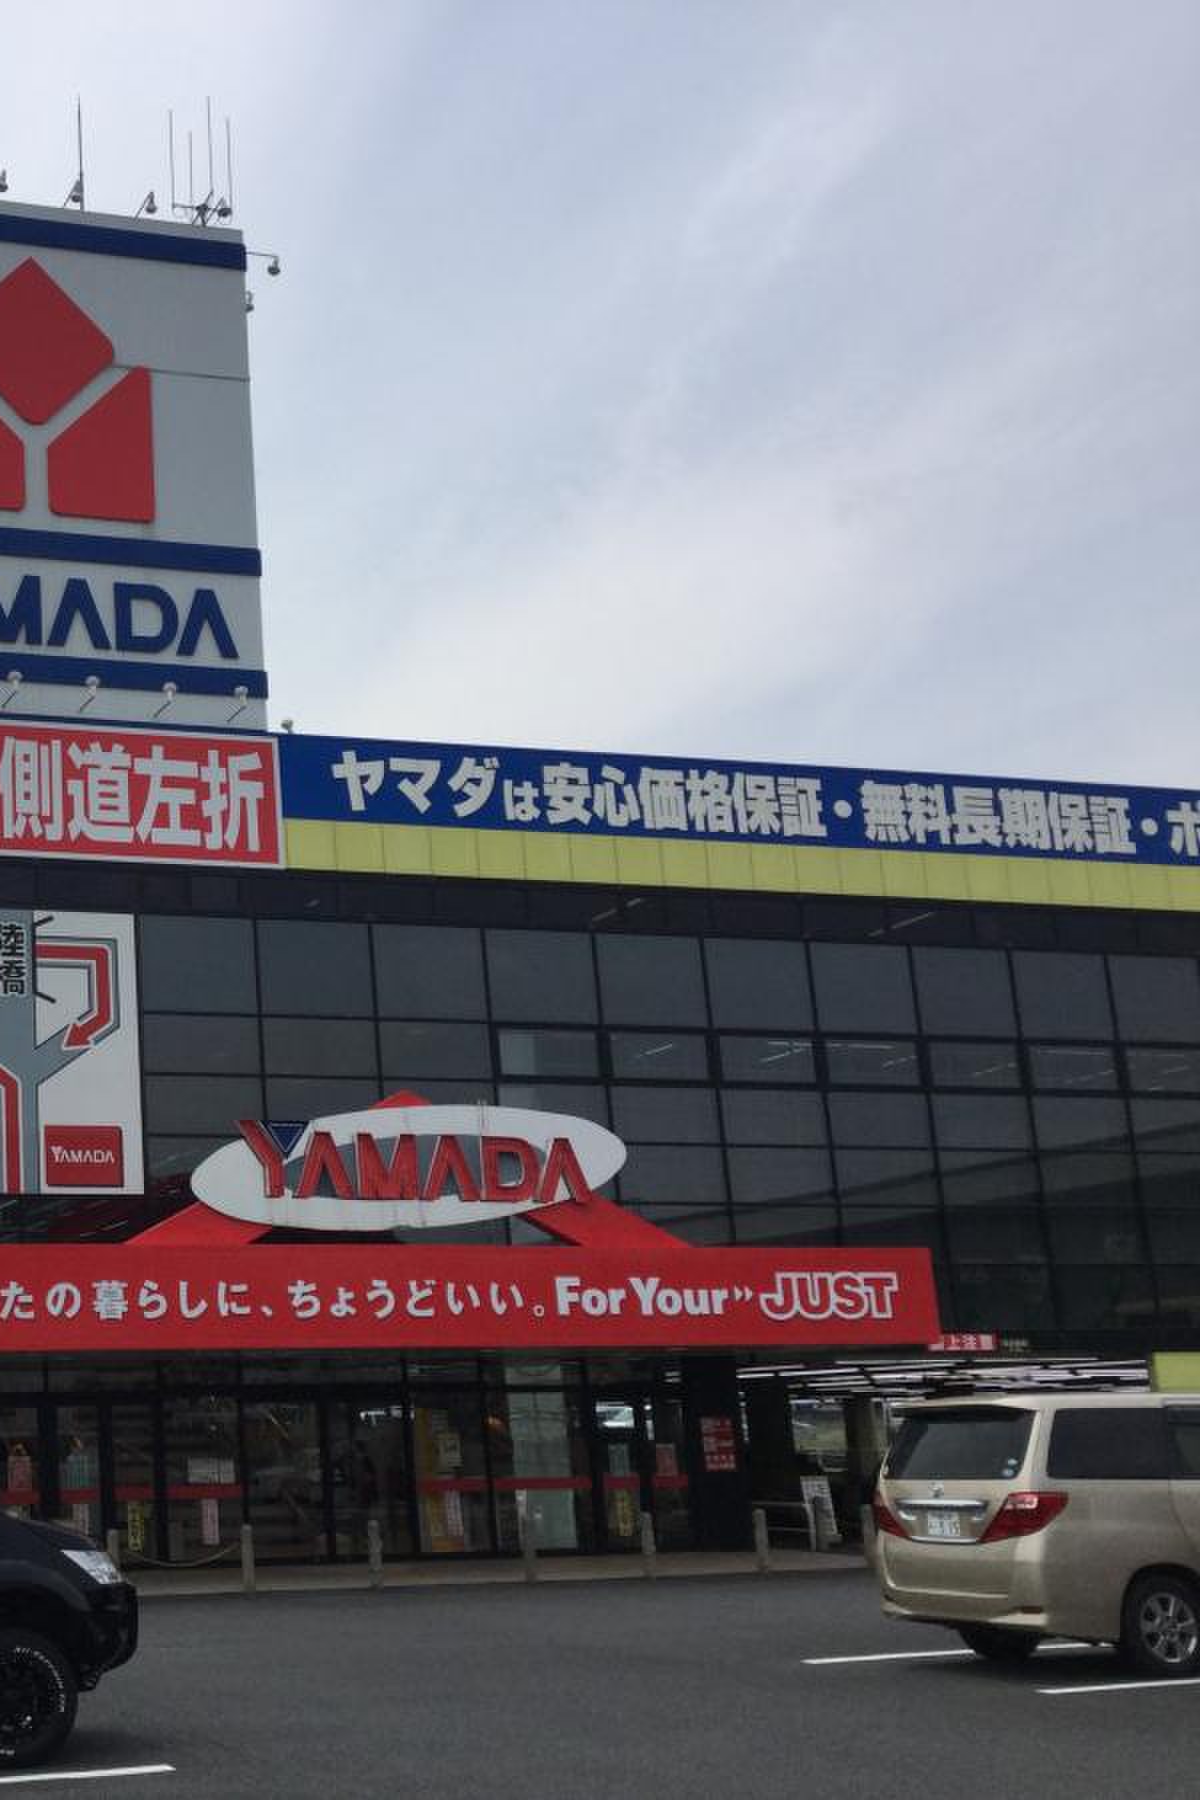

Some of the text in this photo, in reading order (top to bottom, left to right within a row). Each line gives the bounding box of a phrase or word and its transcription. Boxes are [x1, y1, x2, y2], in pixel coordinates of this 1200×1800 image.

[0, 736, 266, 852] 側道左折
[50, 1145, 115, 1164] YAMADA
[234, 1119, 595, 1203] YAMADA
[554, 1275, 625, 1317] For
[759, 1271, 899, 1321] JUST
